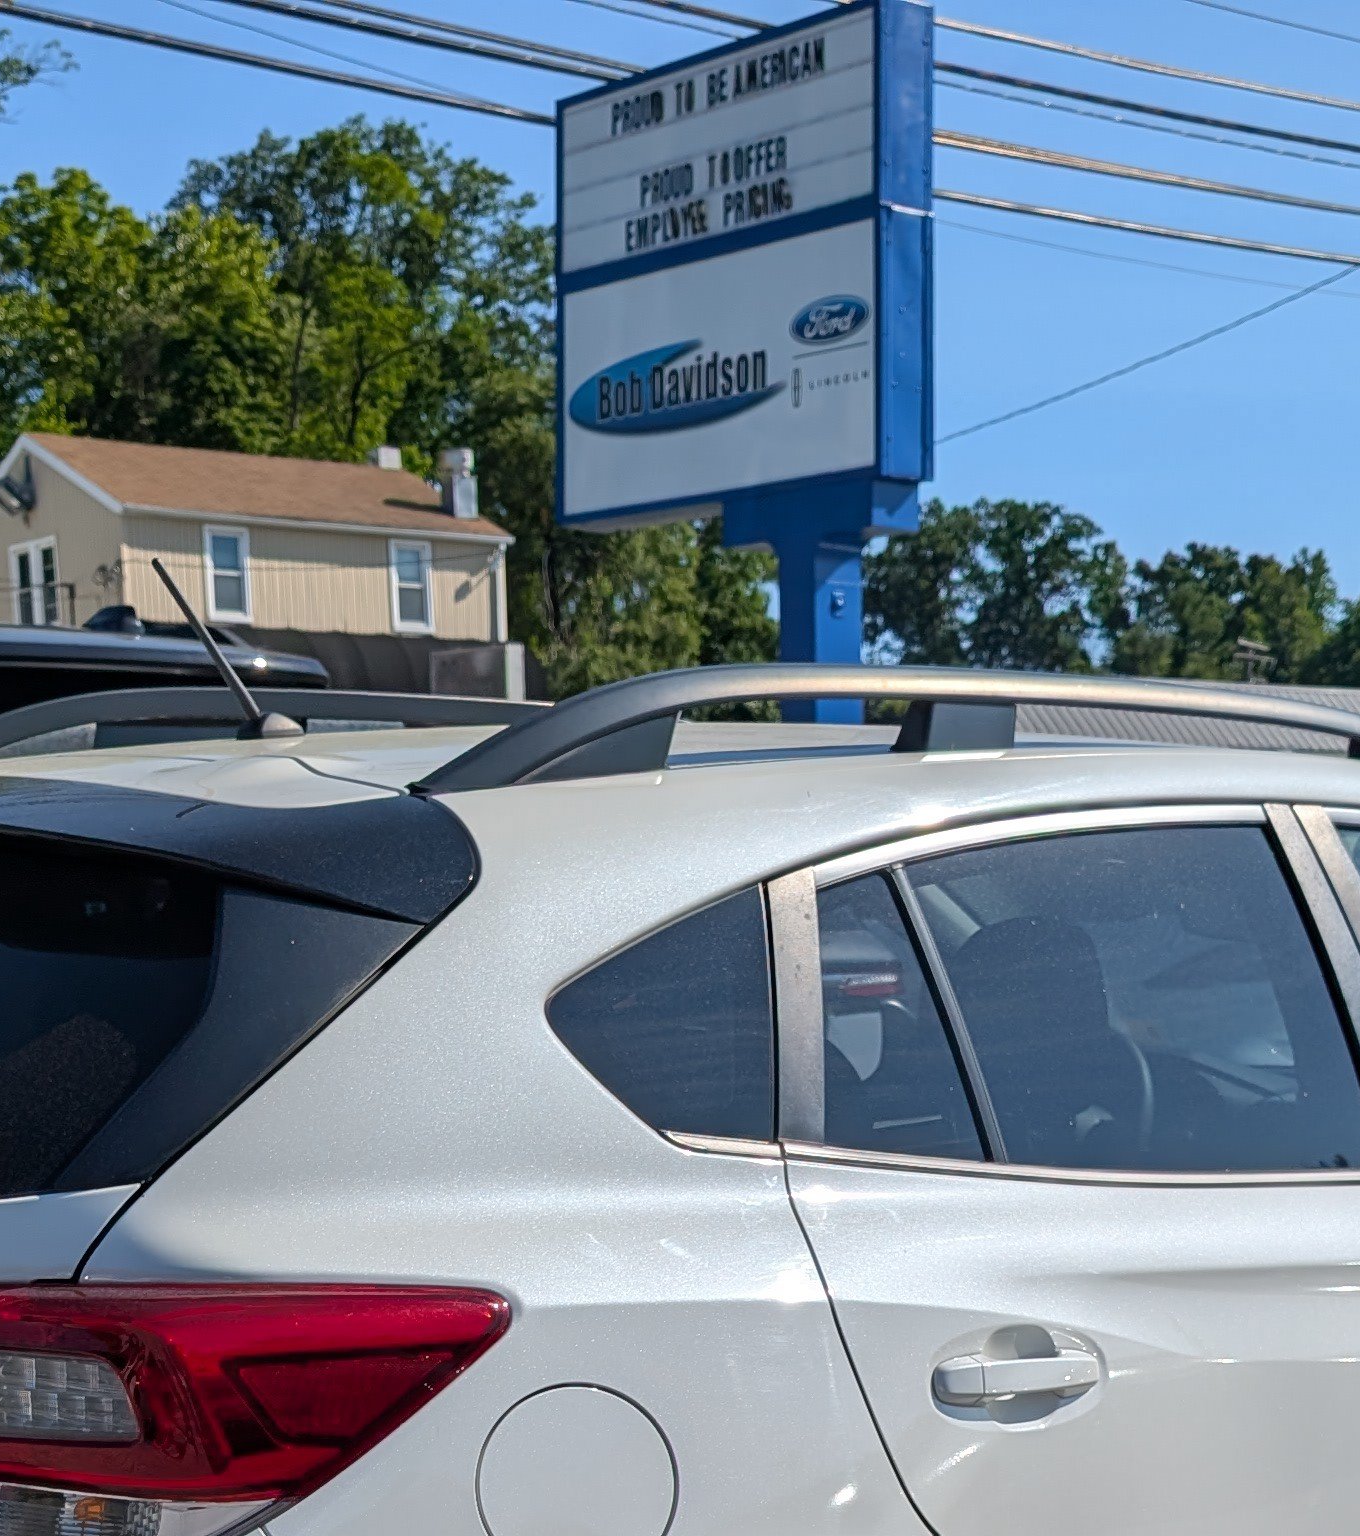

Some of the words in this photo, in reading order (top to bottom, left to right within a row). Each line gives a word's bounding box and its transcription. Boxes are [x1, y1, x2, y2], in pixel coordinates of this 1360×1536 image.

[611, 91, 664, 138] PROUD
[676, 79, 695, 117] TO
[706, 68, 729, 108] BE
[733, 37, 825, 98] AMERICAN
[640, 162, 693, 209] PROUD
[707, 151, 731, 189] TO
[733, 135, 787, 183] OFFER
[625, 198, 707, 253] EMPLOYEE
[724, 176, 793, 228] PRICING
[803, 303, 857, 339] Ford
[598, 371, 643, 421] Bob
[650, 349, 767, 411] Davidson
